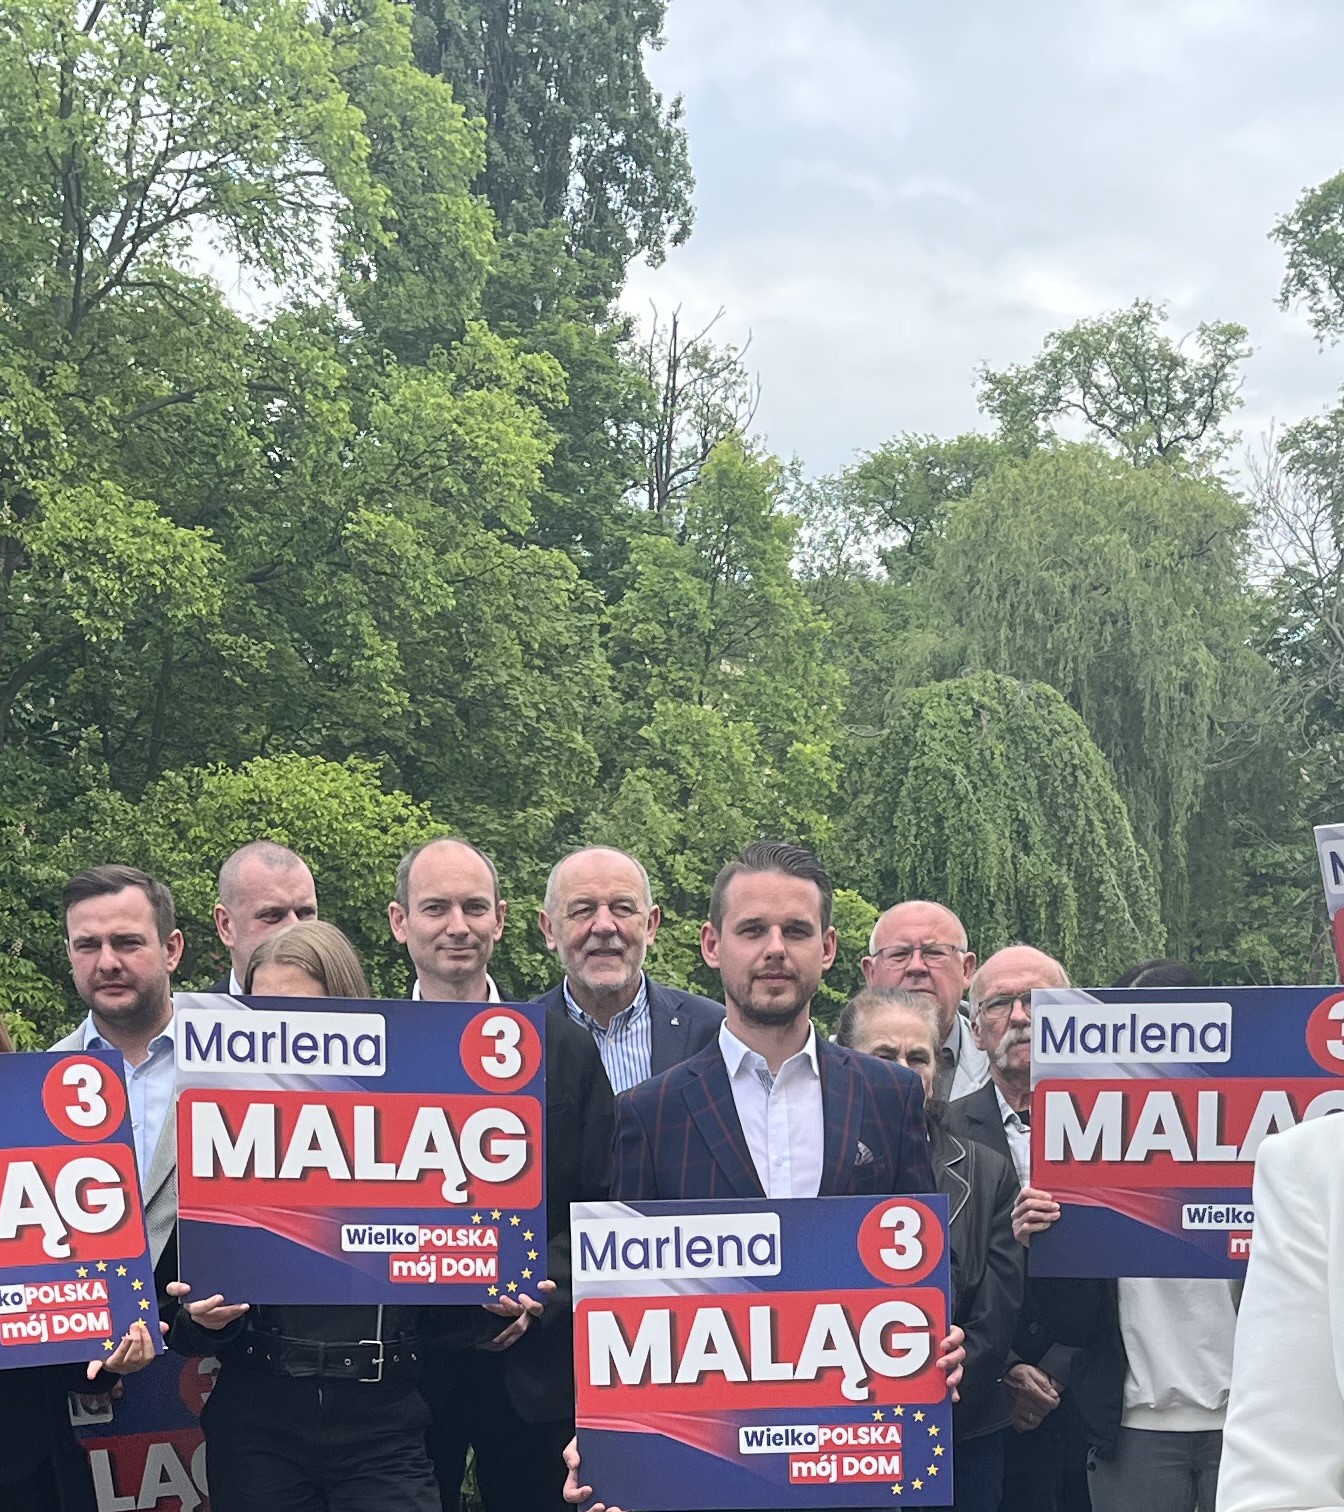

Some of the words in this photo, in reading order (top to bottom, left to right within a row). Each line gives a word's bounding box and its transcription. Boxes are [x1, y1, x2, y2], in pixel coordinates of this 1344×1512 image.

[185, 1021, 380, 1065] Marlena
[481, 1016, 521, 1078] 3
[1041, 1013, 1226, 1053] Marlena
[62, 1063, 107, 1127] 3
[192, 1102, 526, 1203] MALĄG
[347, 1228, 497, 1247] WielkoPOLSKA
[580, 1226, 775, 1271] Marlena
[879, 1206, 922, 1270] 3
[393, 1258, 436, 1282] mój
[442, 1258, 495, 1277] DOM
[2, 1318, 48, 1341] mój
[53, 1312, 109, 1335] DOM
[588, 1301, 929, 1400] MALĄG
[744, 1426, 900, 1446] WielkoPOLSKA
[792, 1458, 837, 1482] mój
[843, 1456, 899, 1476] DOM
